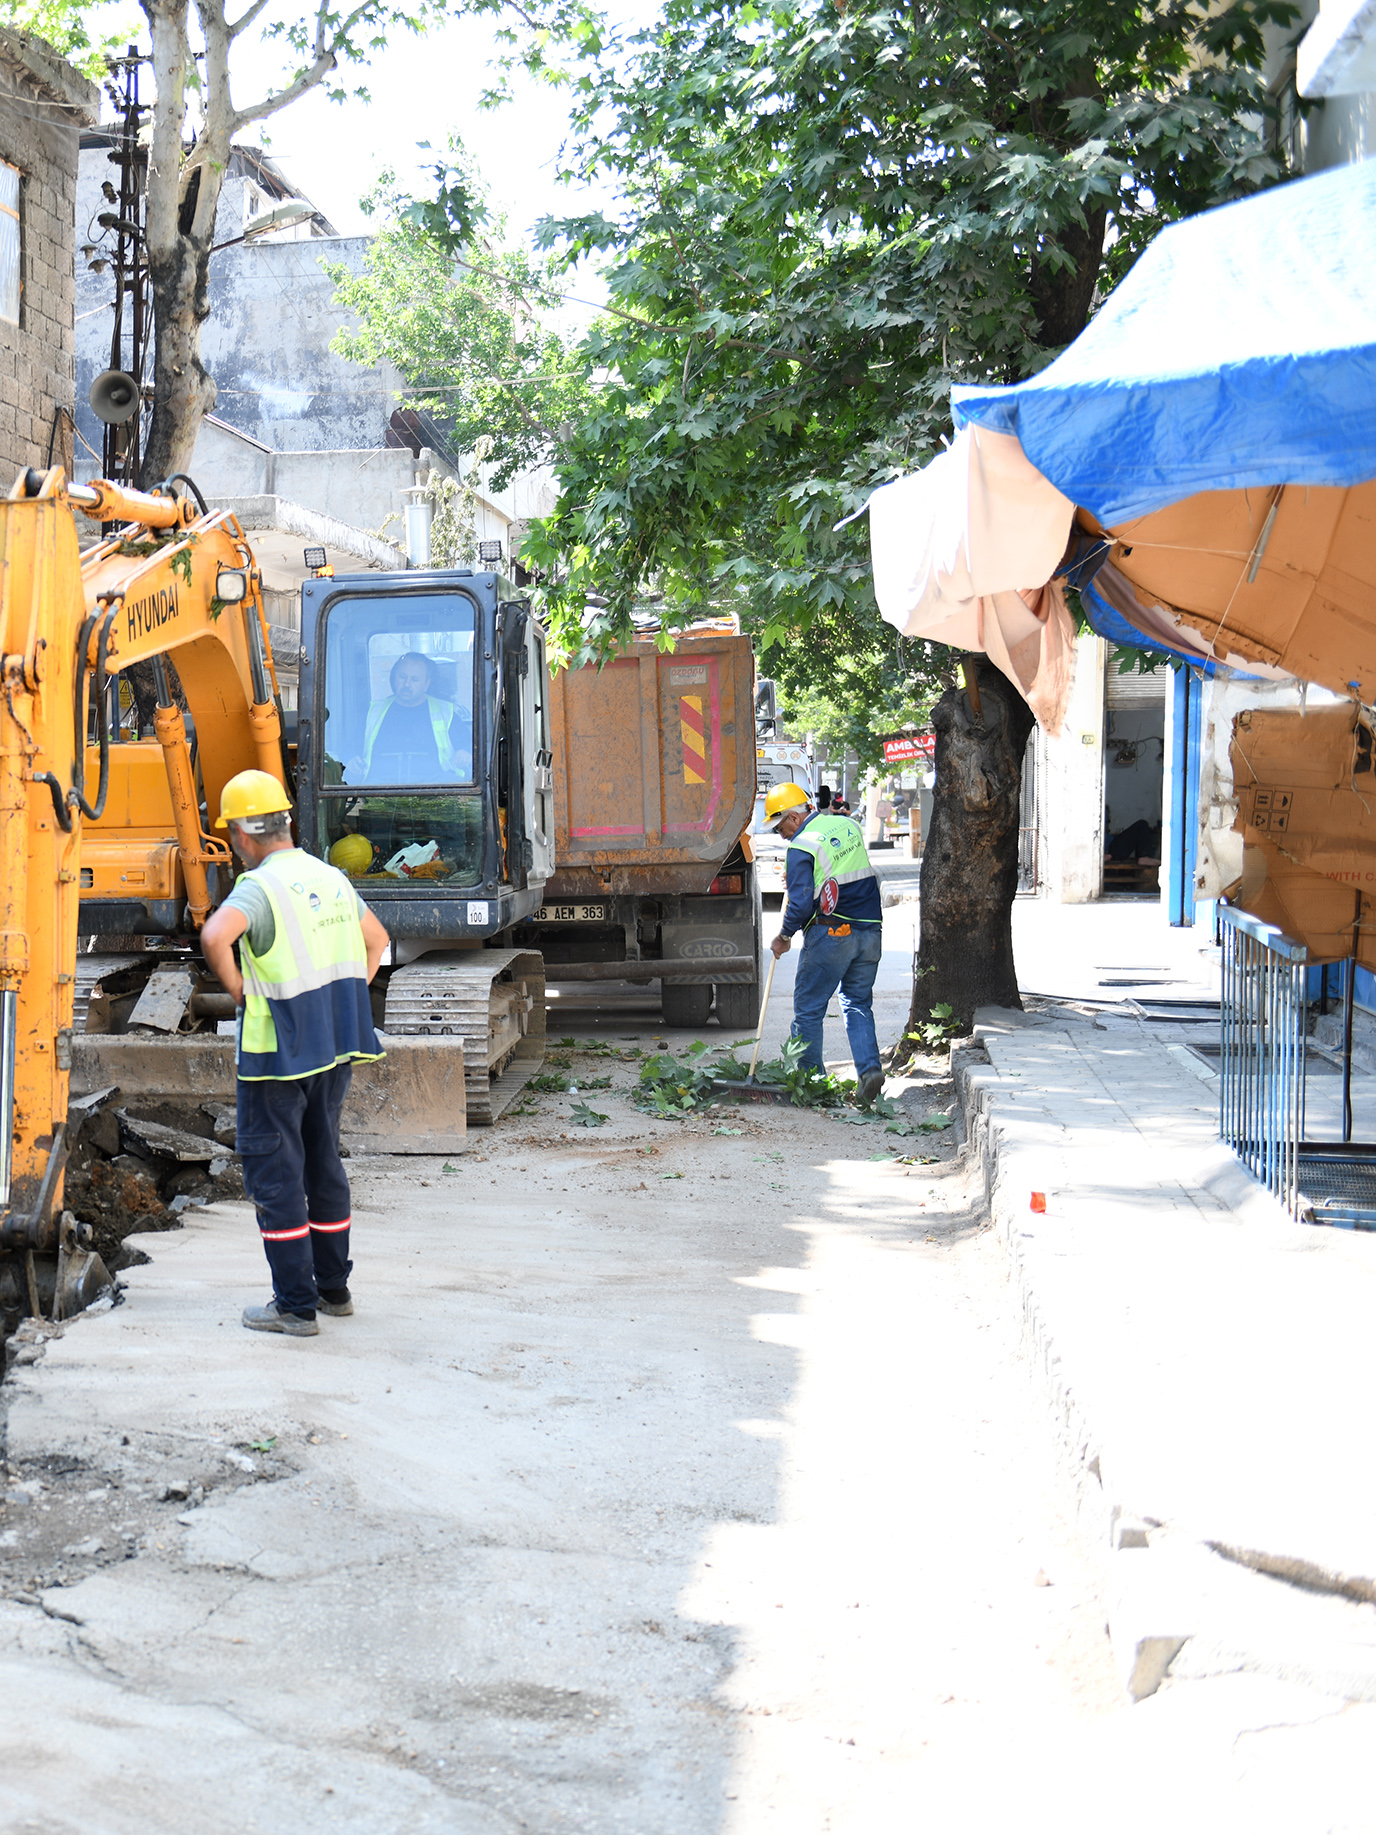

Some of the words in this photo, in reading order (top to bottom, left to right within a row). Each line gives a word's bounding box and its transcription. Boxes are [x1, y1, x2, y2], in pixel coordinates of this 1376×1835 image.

[127, 582, 179, 643] HYUNDAI
[886, 737, 936, 753] AMBALA
[1326, 871, 1361, 881] WITH
[1365, 872, 1376, 882] C
[824, 882, 835, 908] DUR
[470, 912, 483, 923] 100
[533, 907, 547, 920] 46
[554, 907, 575, 920] AEM
[581, 906, 603, 919] 363
[685, 943, 733, 957] CARGO
